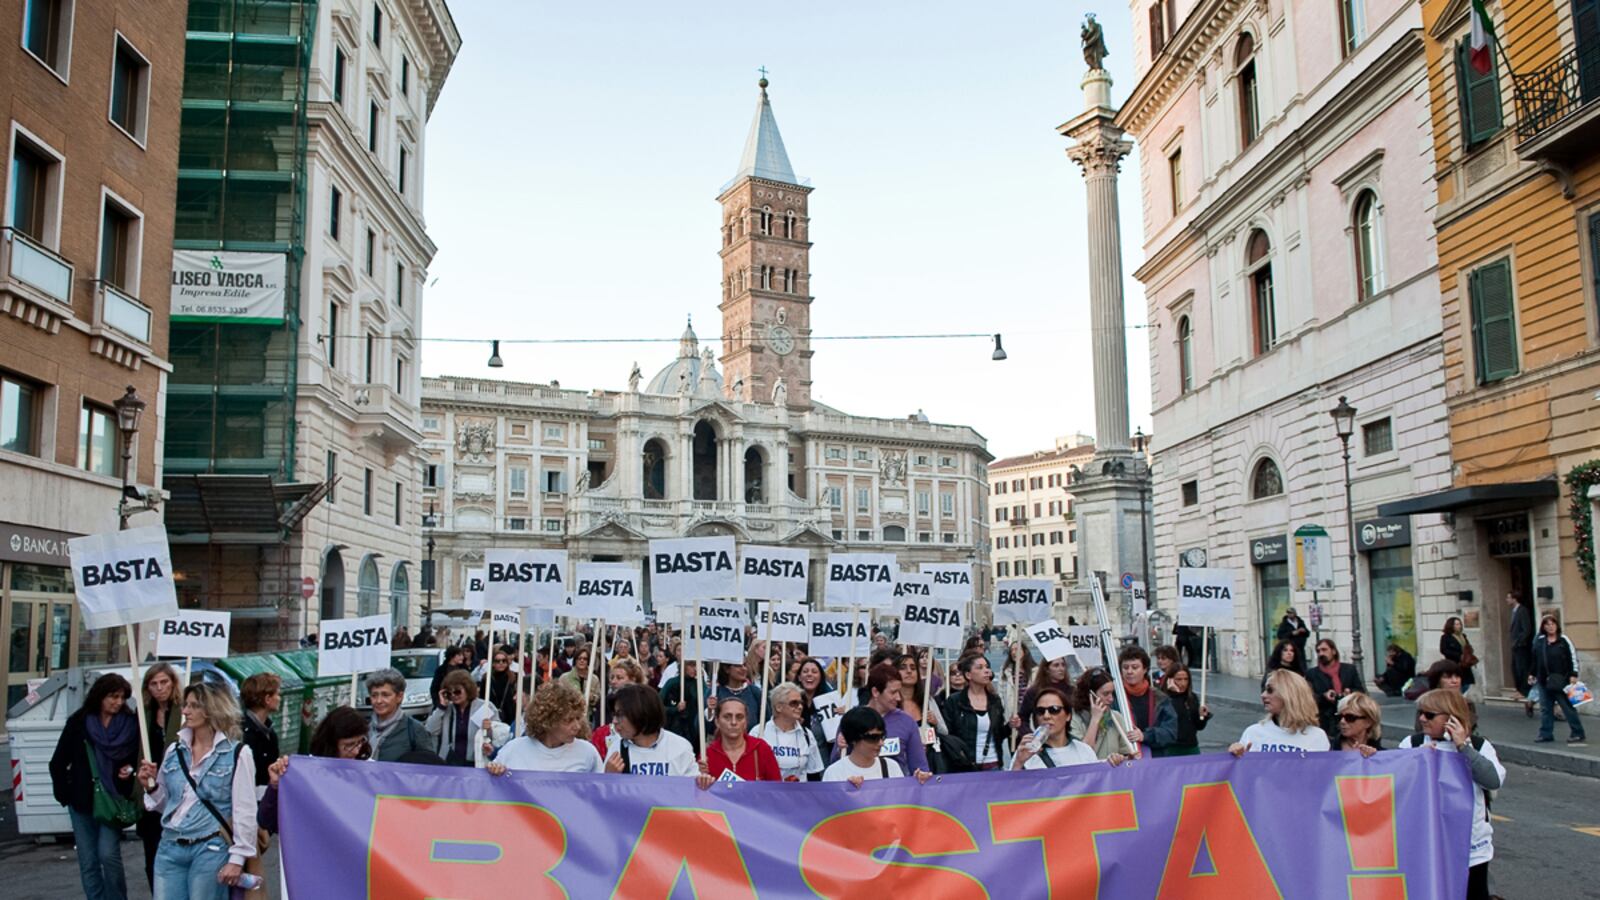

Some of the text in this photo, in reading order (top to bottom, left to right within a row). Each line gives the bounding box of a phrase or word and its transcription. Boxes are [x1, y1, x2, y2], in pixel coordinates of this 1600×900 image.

[217, 272, 264, 288] VACCA
[180, 288, 252, 298] Impresa Edile
[23, 536, 60, 556] BANCA
[655, 550, 733, 574] BASTA
[744, 557, 805, 578] BASTA
[82, 557, 163, 587] BASTA
[488, 562, 562, 582] BASTA
[830, 564, 892, 583] BASTA
[923, 571, 970, 584] ASTA
[578, 579, 635, 597] BASTA
[893, 582, 930, 597] ASTA
[998, 588, 1049, 605] BASTA
[1183, 584, 1232, 600] BASTA
[761, 610, 806, 627] BASTA
[904, 604, 960, 627] BASTA
[162, 620, 226, 638] BASTA
[324, 626, 389, 650] BASTA
[812, 622, 868, 639] BASTA
[366, 773, 1409, 900] BASTA!
